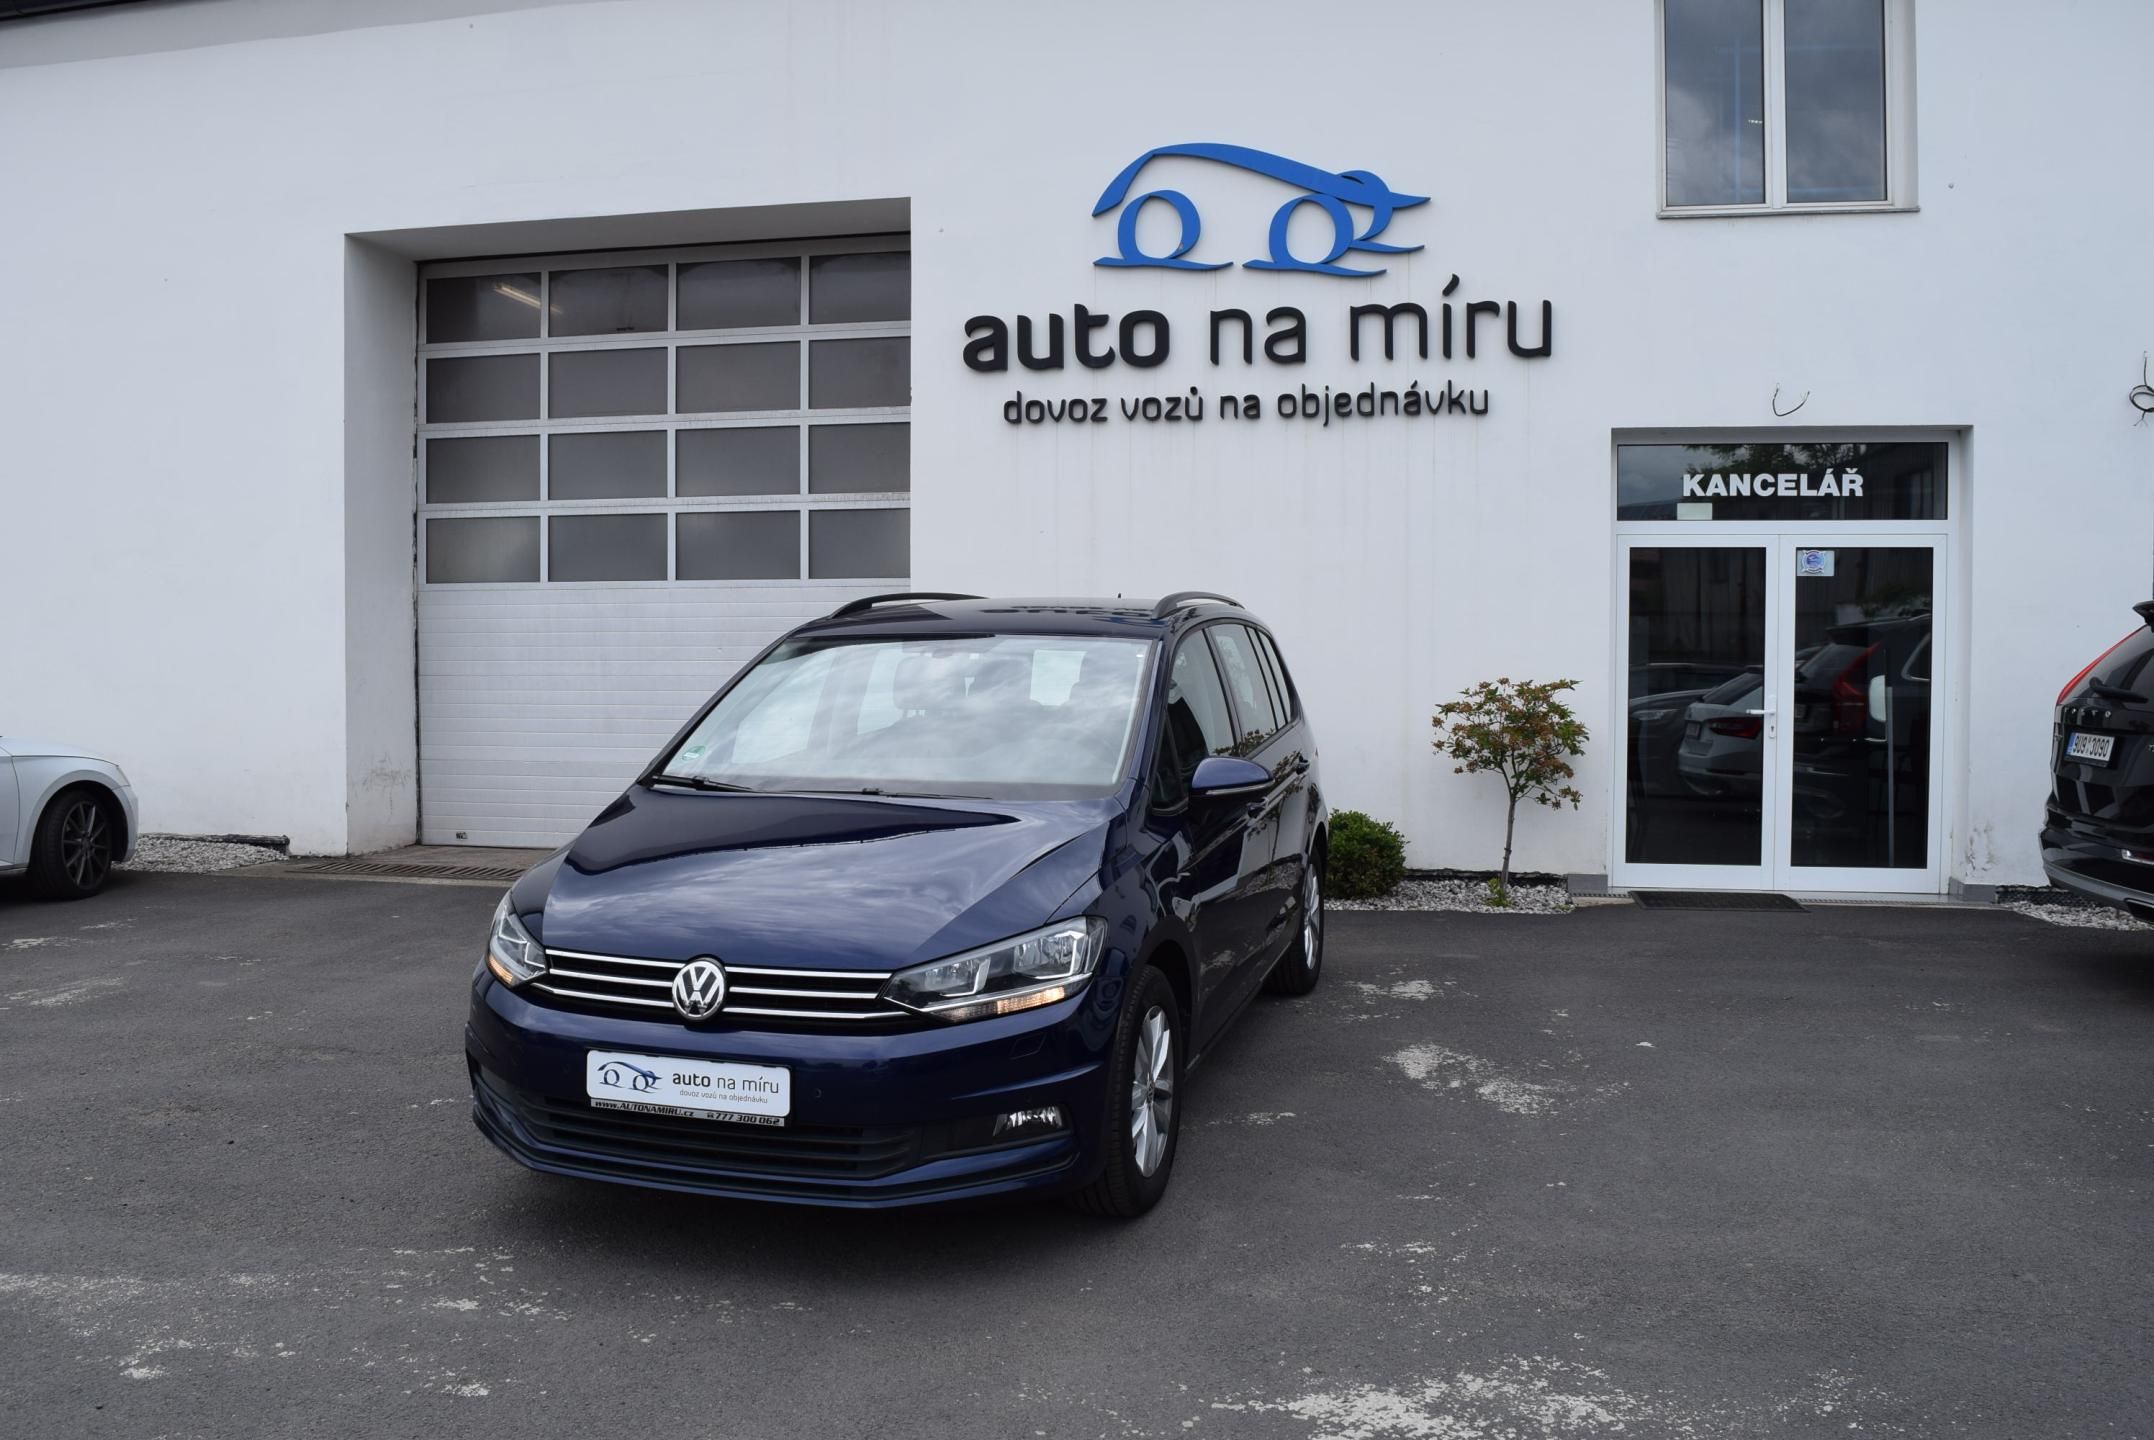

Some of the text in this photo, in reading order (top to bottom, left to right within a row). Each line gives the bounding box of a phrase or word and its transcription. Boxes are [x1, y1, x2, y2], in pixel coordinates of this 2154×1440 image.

[962, 273, 1553, 373] auto na míru
[1002, 380, 1490, 428] dovoz vozů na objednávku
[1682, 468, 1864, 498] KANCELÁŘ
[672, 1072, 779, 1094] auto na míru
[679, 1088, 699, 1098] dovoz
[718, 1093, 727, 1101] na
[728, 1094, 768, 1104] objednávku
[714, 1113, 735, 1122] 777
[736, 1115, 758, 1124] 300
[758, 1117, 780, 1126] 062
